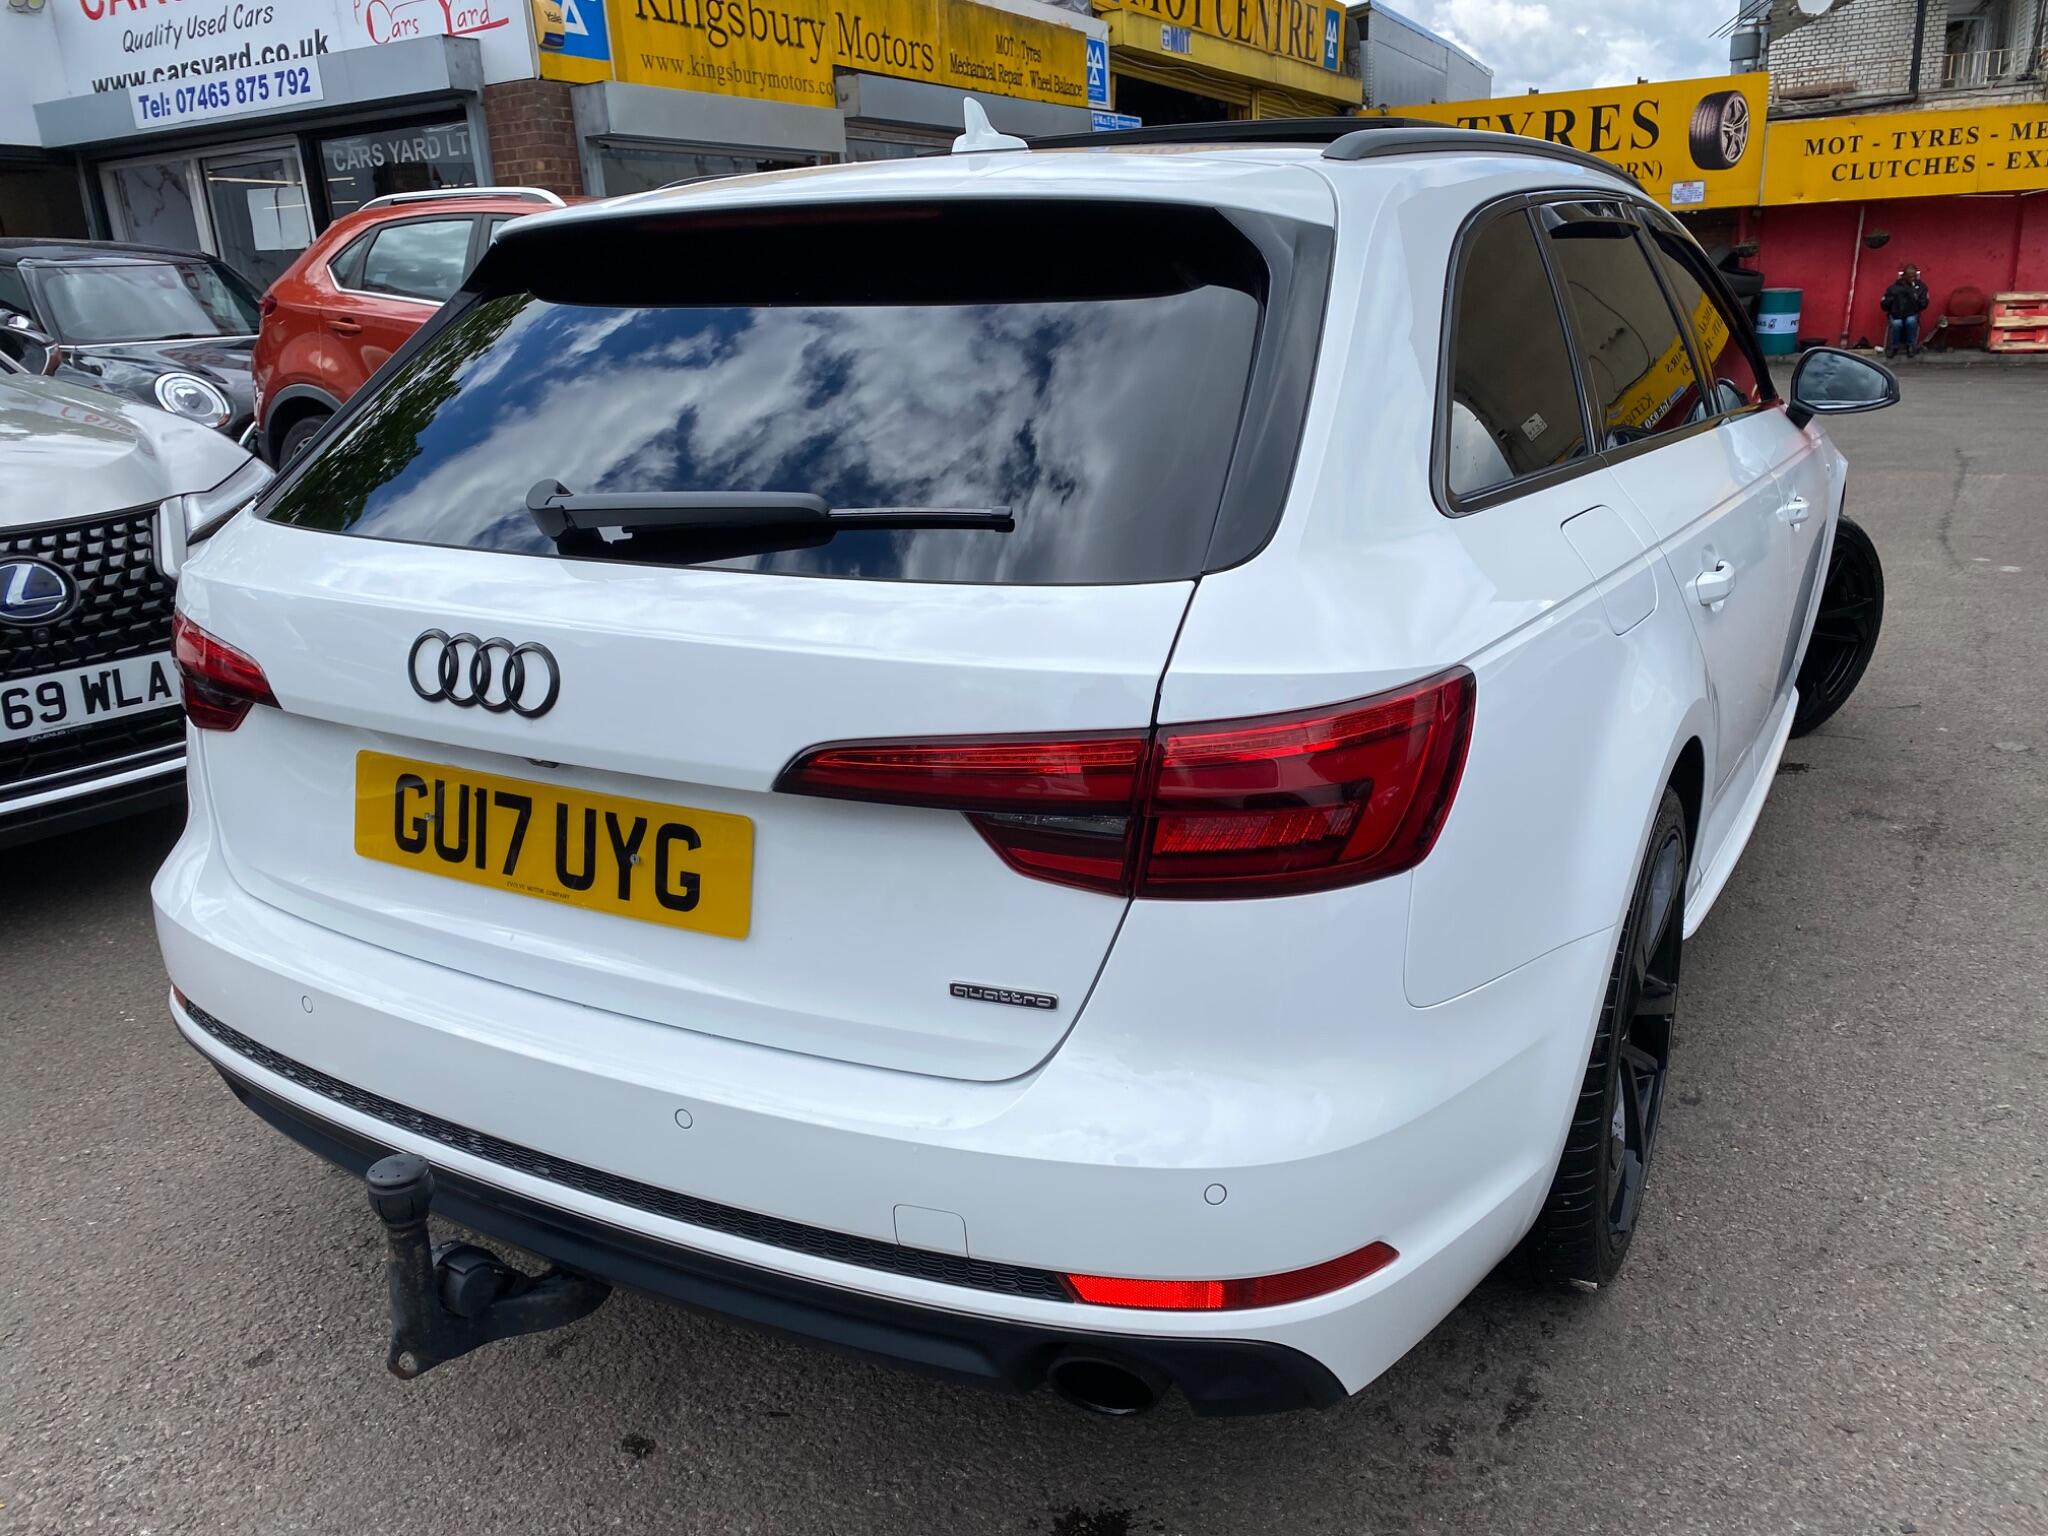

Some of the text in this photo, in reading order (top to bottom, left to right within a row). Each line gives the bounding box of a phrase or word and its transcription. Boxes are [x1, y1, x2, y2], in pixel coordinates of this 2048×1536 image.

[122, 19, 182, 53] Quality
[187, 5, 228, 40] Used
[233, 3, 274, 30] Cars
[366, 0, 500, 44] Cars Yard
[544, 10, 562, 24] Yale
[1215, 0, 1319, 62] CENTRE
[835, 12, 935, 72] Motors
[995, 34, 1015, 55] MOT
[1020, 40, 1041, 66] Tyres
[138, 66, 311, 120] Tel: 07465 875 792
[950, 52, 996, 82] Mechanical
[998, 63, 1023, 90] Repair
[1029, 71, 1053, 93] Wheel
[1053, 74, 1082, 97] Balance
[333, 143, 385, 171] CARS
[388, 137, 441, 164] YARD
[1803, 135, 1864, 157] MOT
[1891, 126, 1980, 150] TYRES
[2009, 119, 2048, 142] ME
[1831, 154, 1976, 181] CLUTCHES
[2004, 148, 2048, 171] EX
[0, 660, 173, 730] 69 WLA
[395, 772, 702, 912] GU17 UYG
[953, 985, 1052, 1008] quattro
